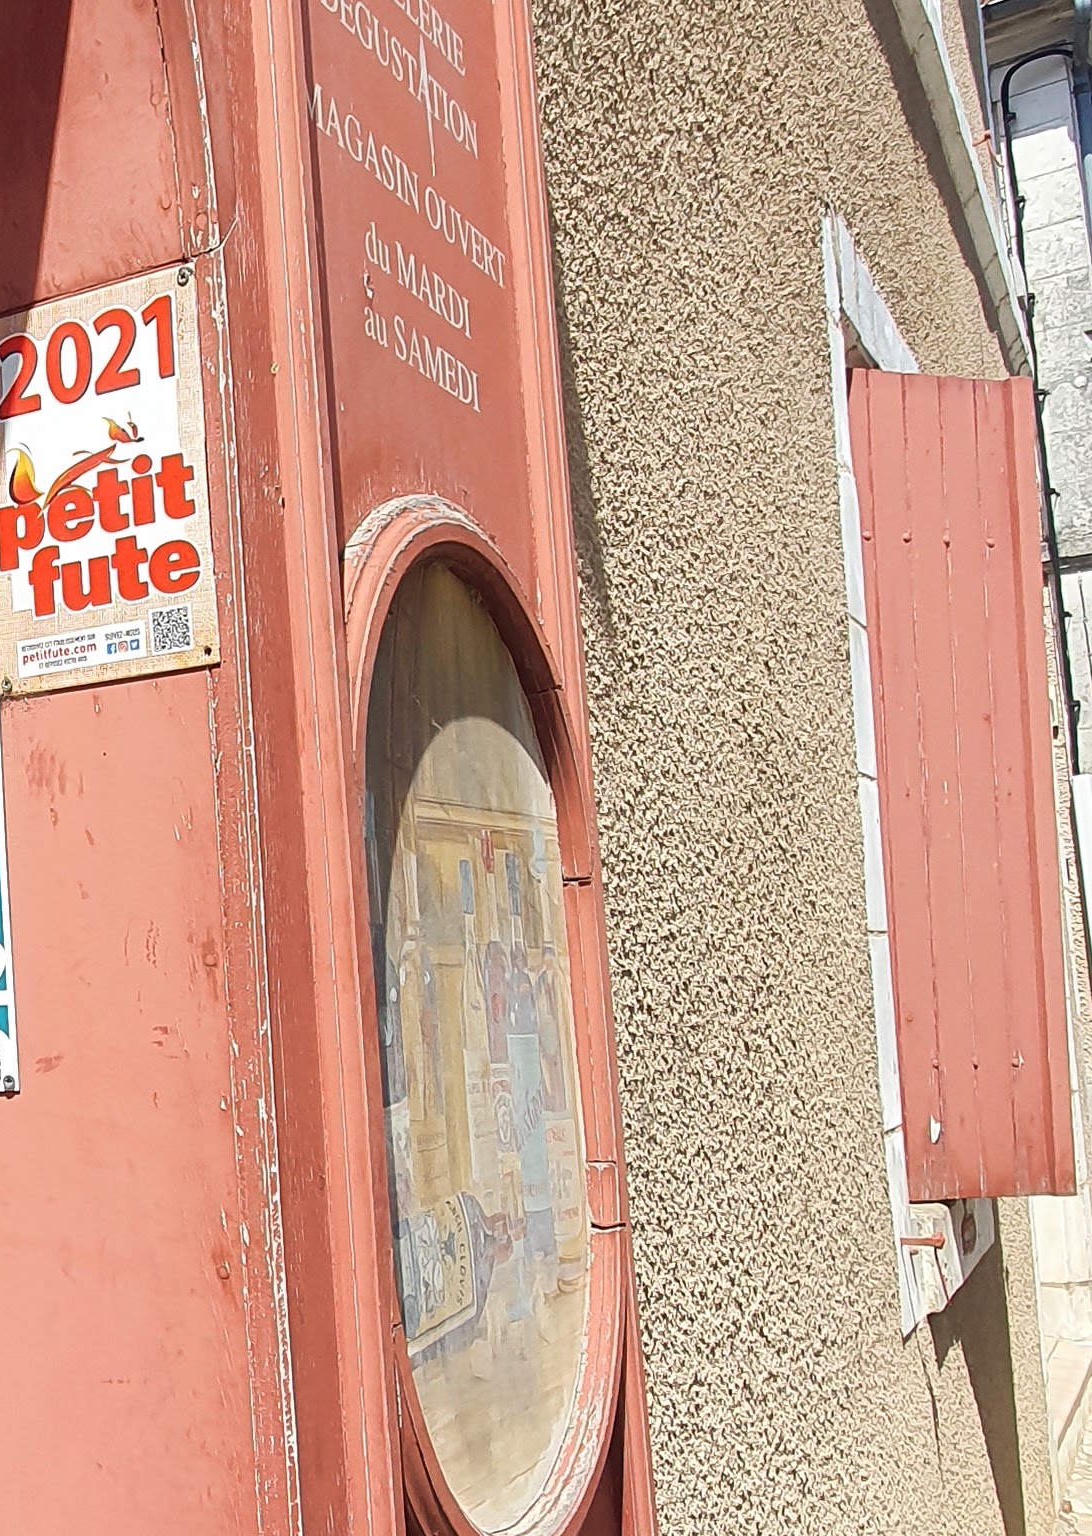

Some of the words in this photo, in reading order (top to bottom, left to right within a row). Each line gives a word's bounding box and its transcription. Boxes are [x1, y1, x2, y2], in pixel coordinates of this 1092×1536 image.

[306, 83, 420, 215] MAGASIN
[425, 185, 507, 289] OUVERT
[365, 221, 391, 275] du
[394, 240, 473, 339] MARDI
[364, 305, 389, 350] au
[394, 314, 482, 414] SAMEDI
[28, 535, 200, 617] fute
[23, 643, 97, 666] petitfute.com
